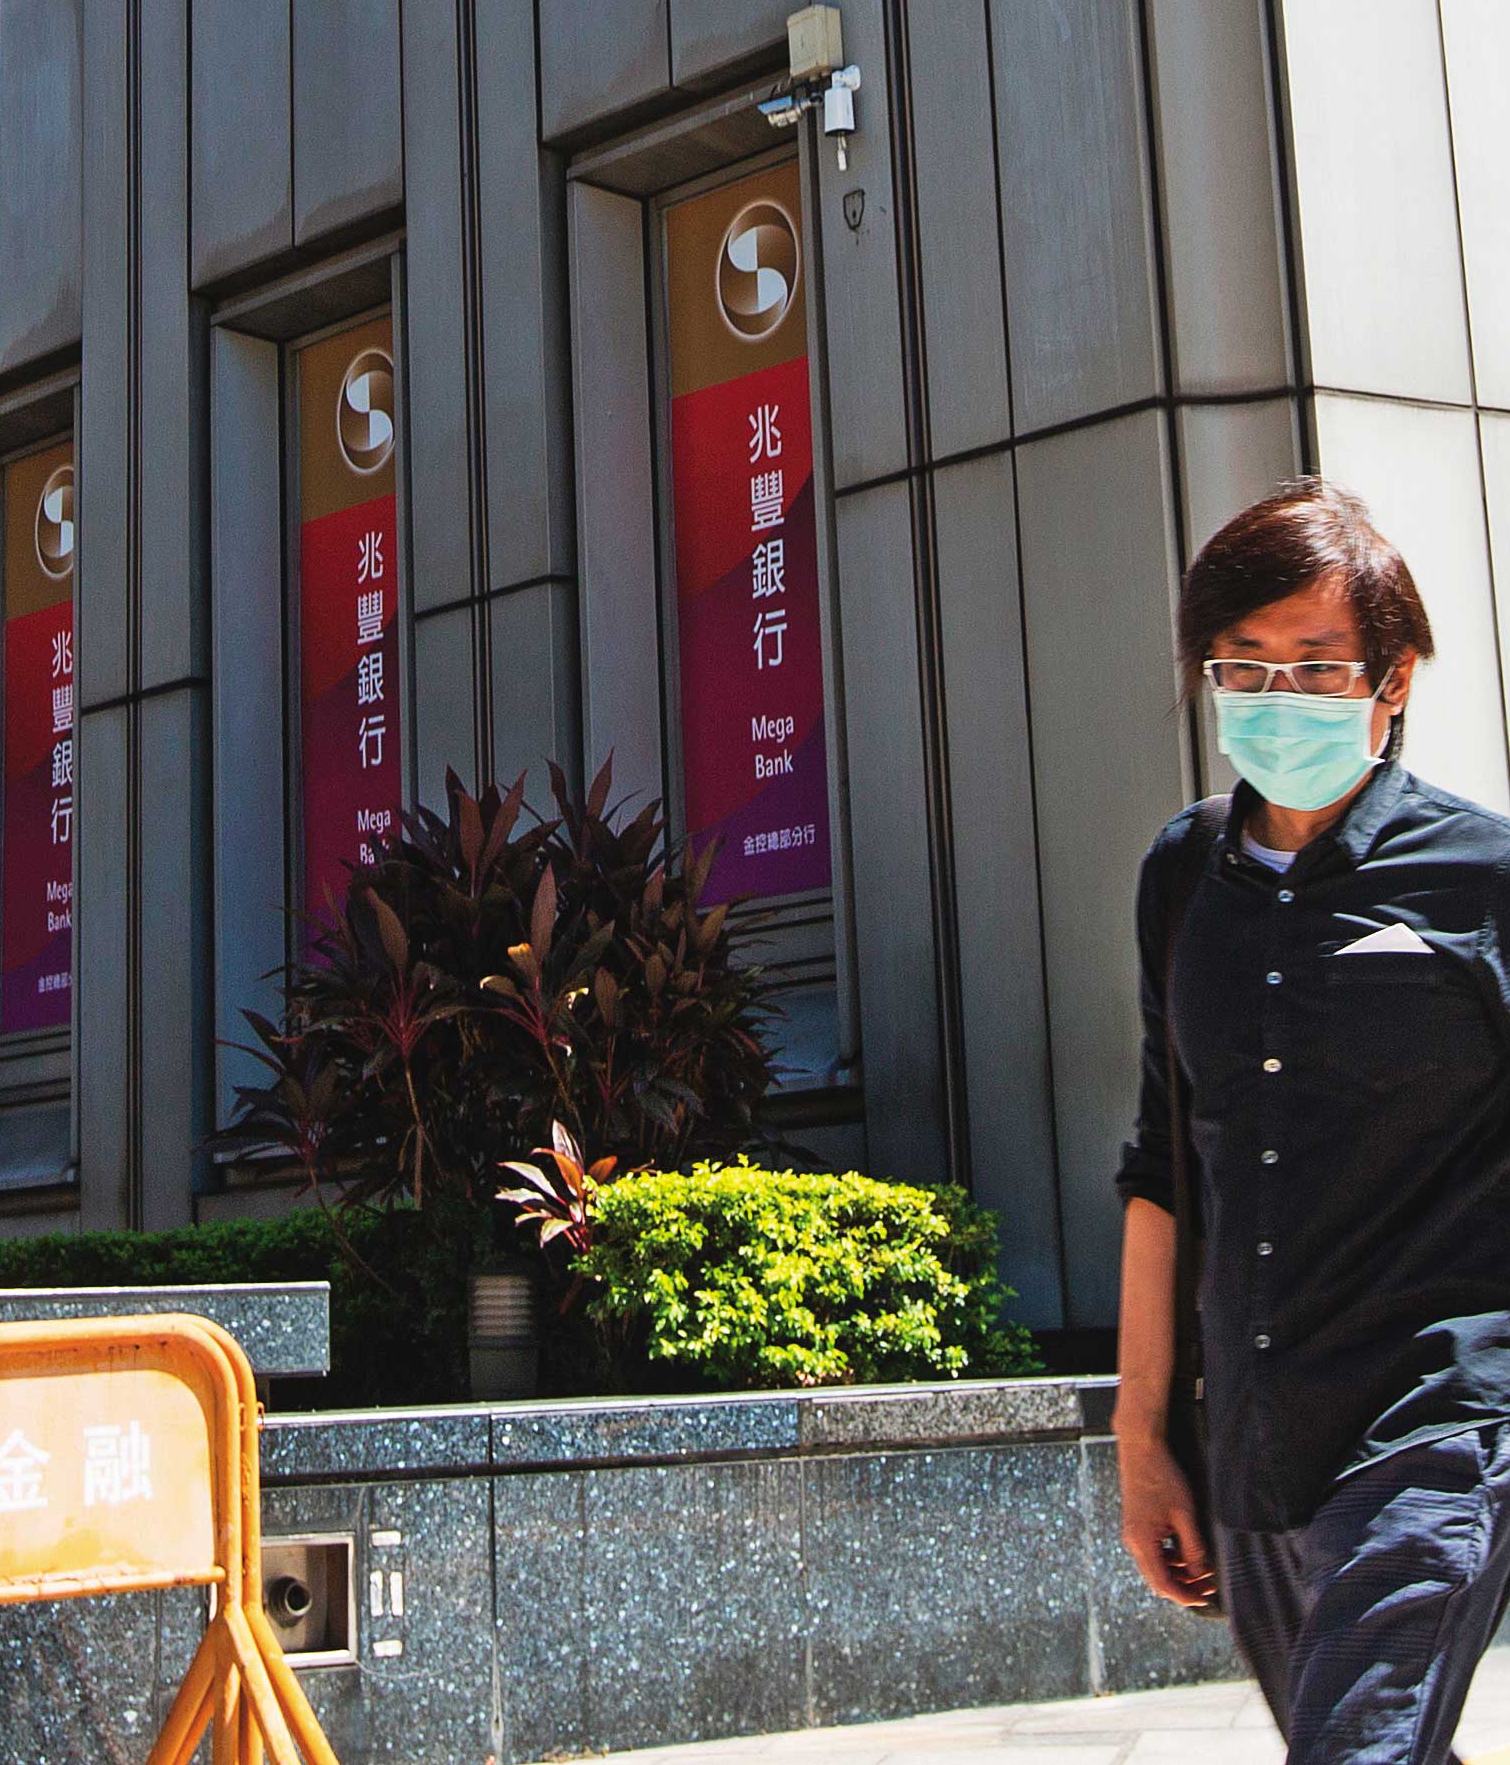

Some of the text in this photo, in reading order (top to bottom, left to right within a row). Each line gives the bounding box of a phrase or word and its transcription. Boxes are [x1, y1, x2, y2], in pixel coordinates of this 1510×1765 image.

[748, 403, 788, 671] 兆豐銀行
[357, 530, 387, 770] 兆豐銀行
[50, 630, 73, 845] 兆豐銀行
[751, 714, 795, 744] Mega
[754, 748, 794, 780] Bank
[357, 808, 392, 834] Mega
[46, 880, 73, 904] Mega
[47, 908, 72, 933] Bank
